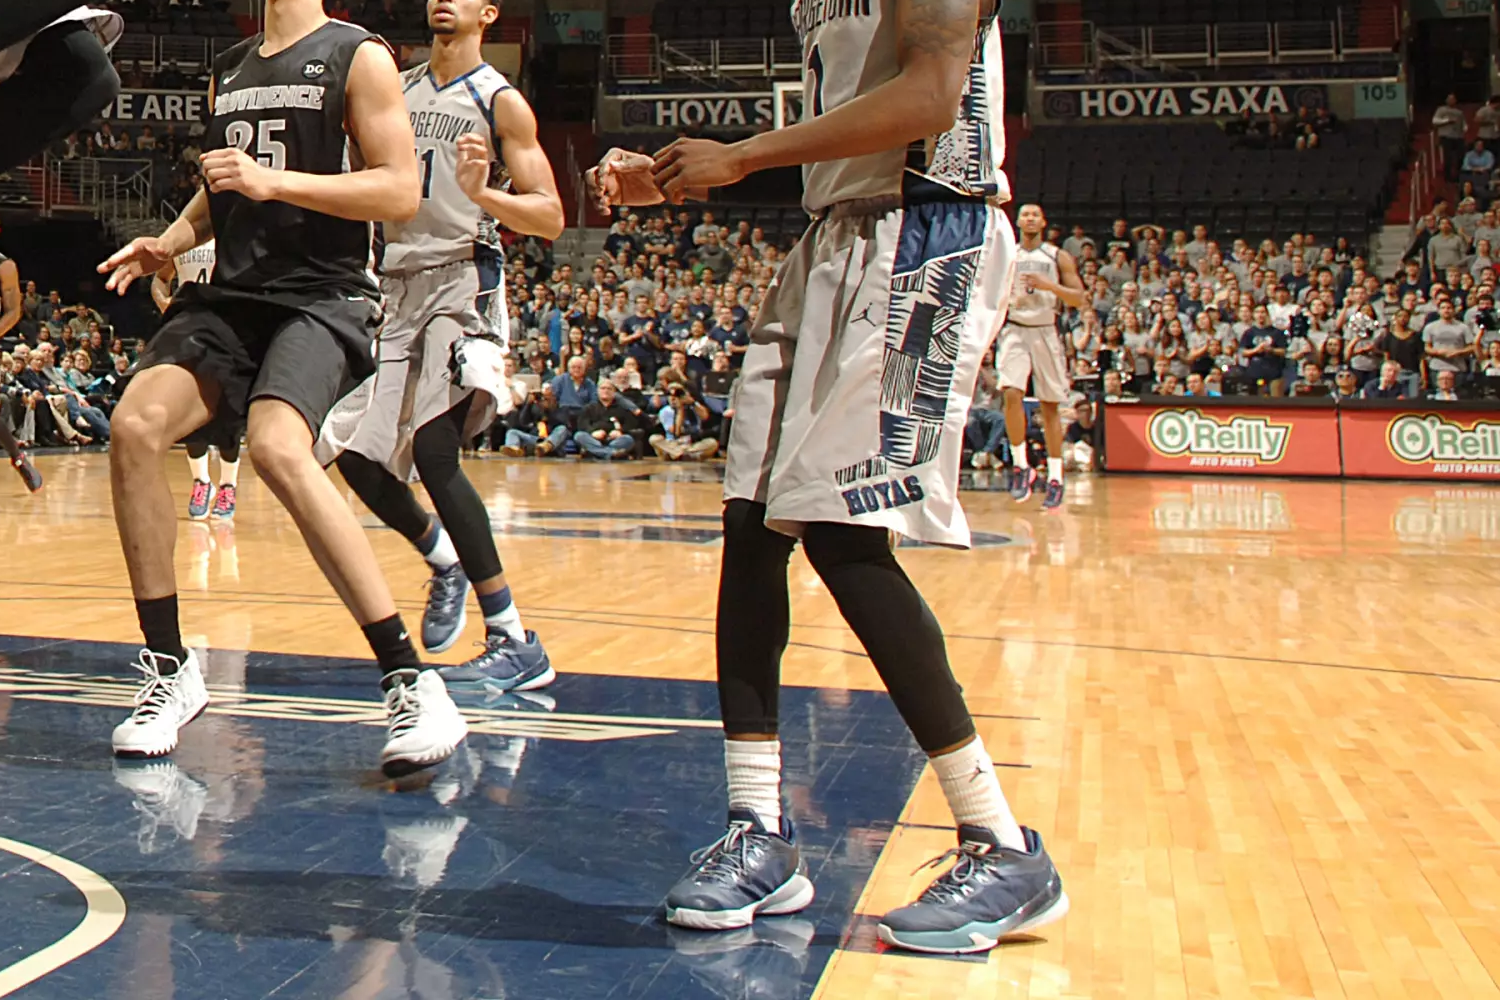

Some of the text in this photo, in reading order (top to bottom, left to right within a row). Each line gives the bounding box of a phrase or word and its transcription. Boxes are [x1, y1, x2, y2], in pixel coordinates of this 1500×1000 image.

[304, 64, 324, 75] DG
[1081, 86, 1288, 118] HOYA SAXA
[1362, 85, 1397, 101] 105
[141, 94, 202, 121] ARE
[656, 100, 748, 126] HOYA
[225, 119, 286, 172] 25
[1151, 411, 1288, 457] O'Reilly
[1393, 416, 1500, 461] O'Reil
[1190, 456, 1256, 468] AUTO PARTS
[1434, 463, 1463, 474] AUTO
[841, 474, 924, 517] HOYAS
